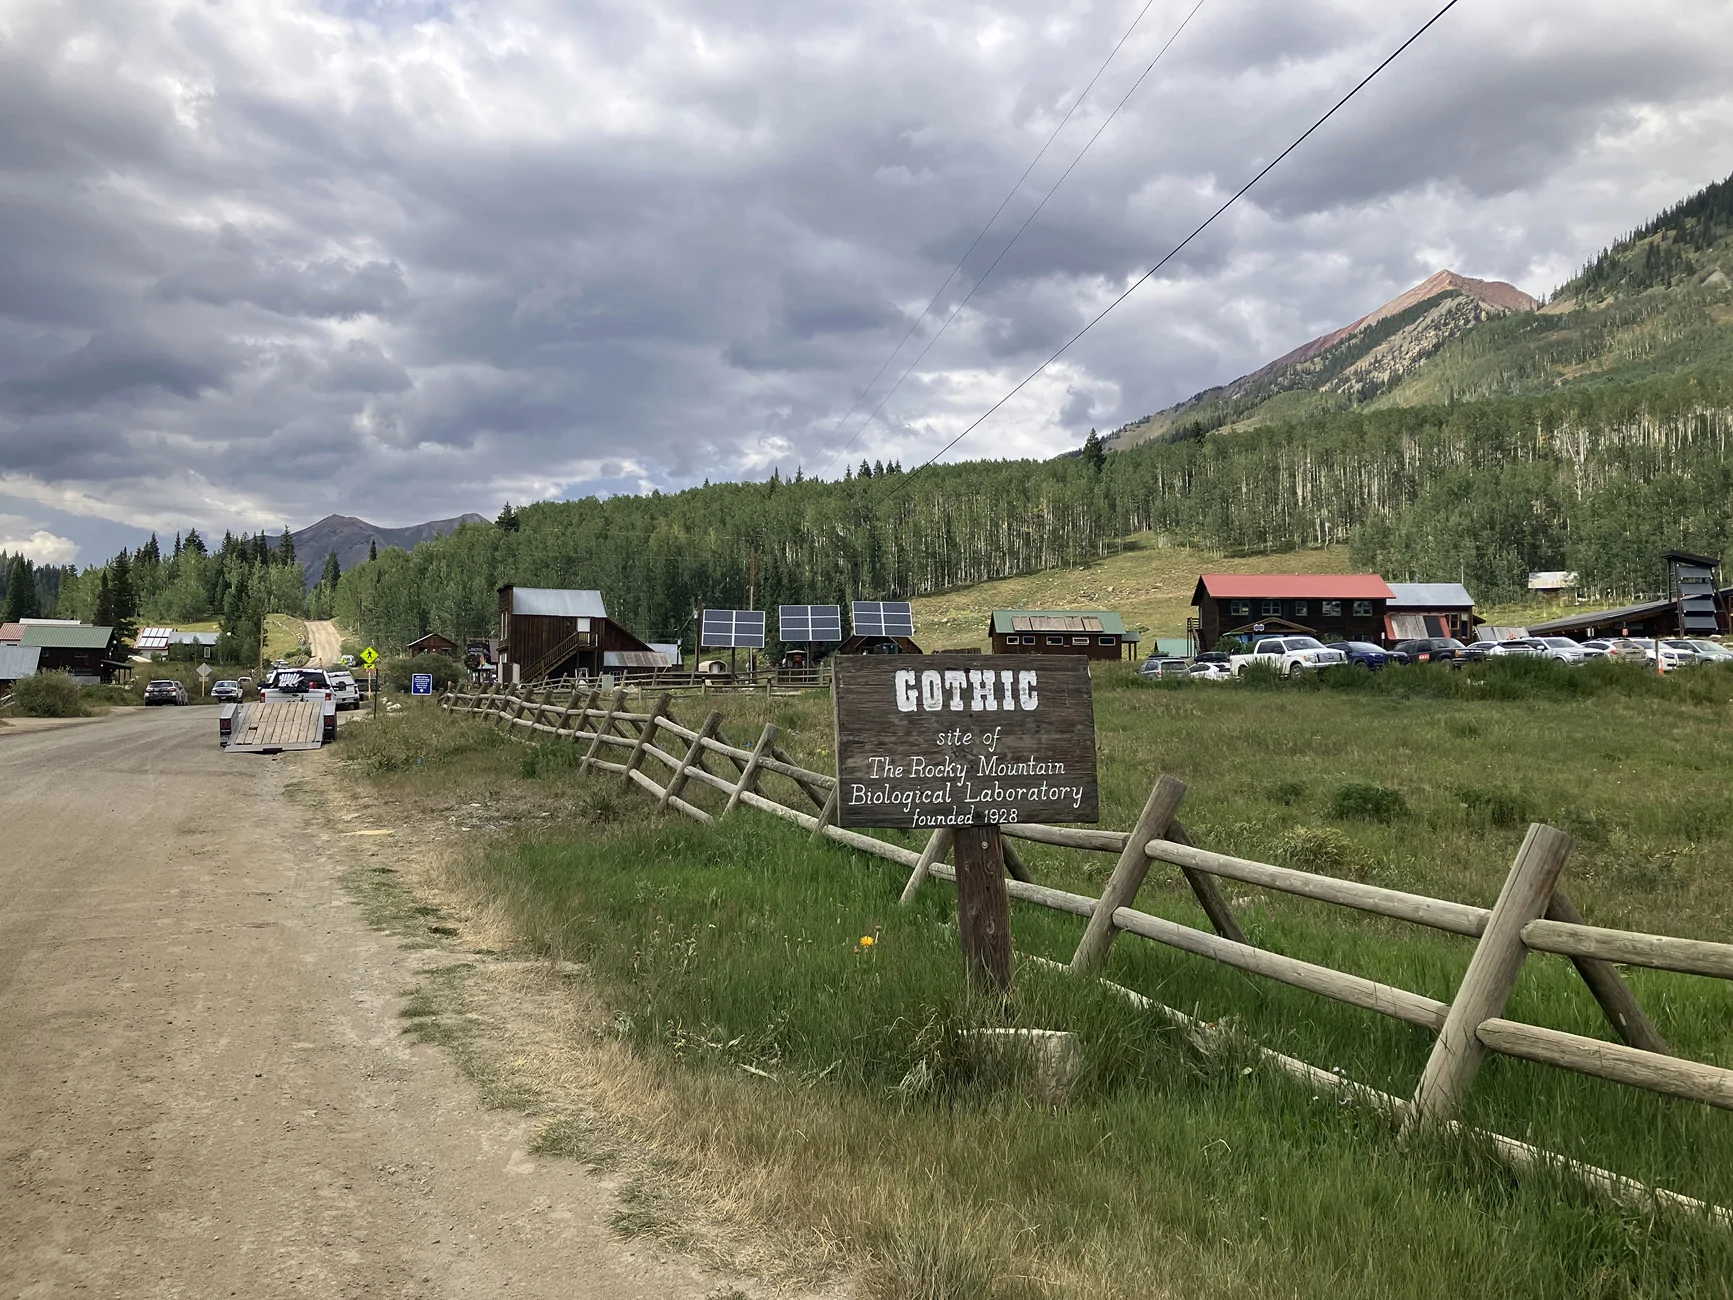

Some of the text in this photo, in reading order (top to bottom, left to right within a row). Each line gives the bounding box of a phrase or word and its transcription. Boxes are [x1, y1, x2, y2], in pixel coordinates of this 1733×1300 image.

[894, 669, 1039, 712] GOTHIC
[937, 726, 1002, 752] site of
[869, 755, 1066, 786] The Rocky Mountain
[849, 780, 1083, 812] Biological Laboratory
[912, 806, 1018, 828] founded 1928
